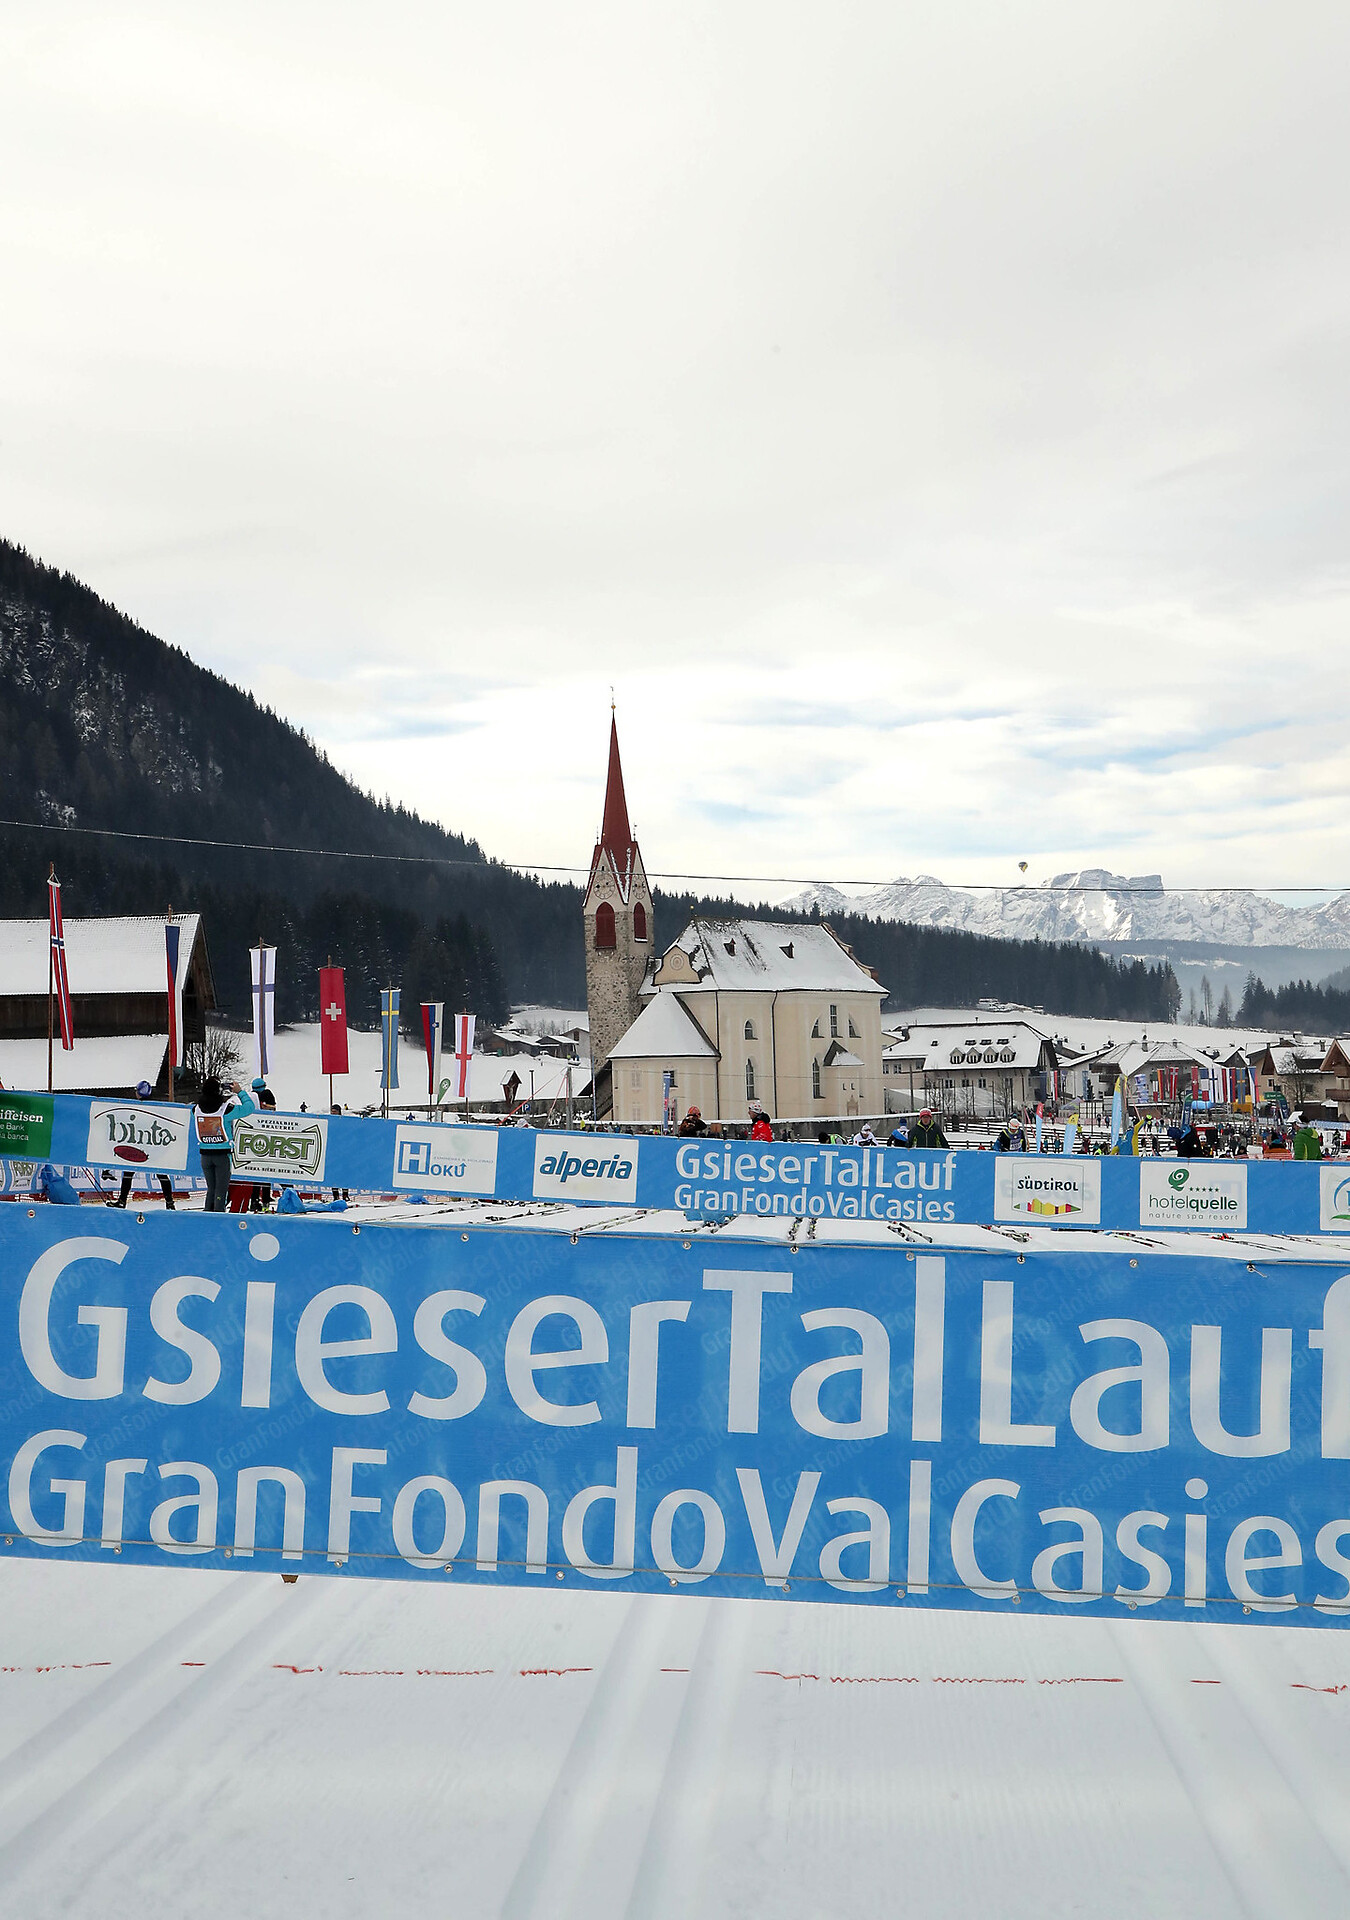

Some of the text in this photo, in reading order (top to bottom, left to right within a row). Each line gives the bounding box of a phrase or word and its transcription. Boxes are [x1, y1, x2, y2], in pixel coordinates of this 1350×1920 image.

[6, 1122, 25, 1132] Bank
[7, 1131, 29, 1141] banca
[106, 1113, 177, 1146] binta
[202, 1135, 224, 1143] OFFICIAL
[238, 1133, 315, 1160] FORST
[539, 1151, 633, 1183] alperia
[675, 1143, 957, 1191] GsieserTalLauf
[674, 1183, 956, 1222] GranFondoValCasies
[1149, 1194, 1239, 1211] hotelquelle
[19, 1233, 1350, 1459] GsieserTalLauf
[8, 1429, 1350, 1615] GranFondoValCasies
